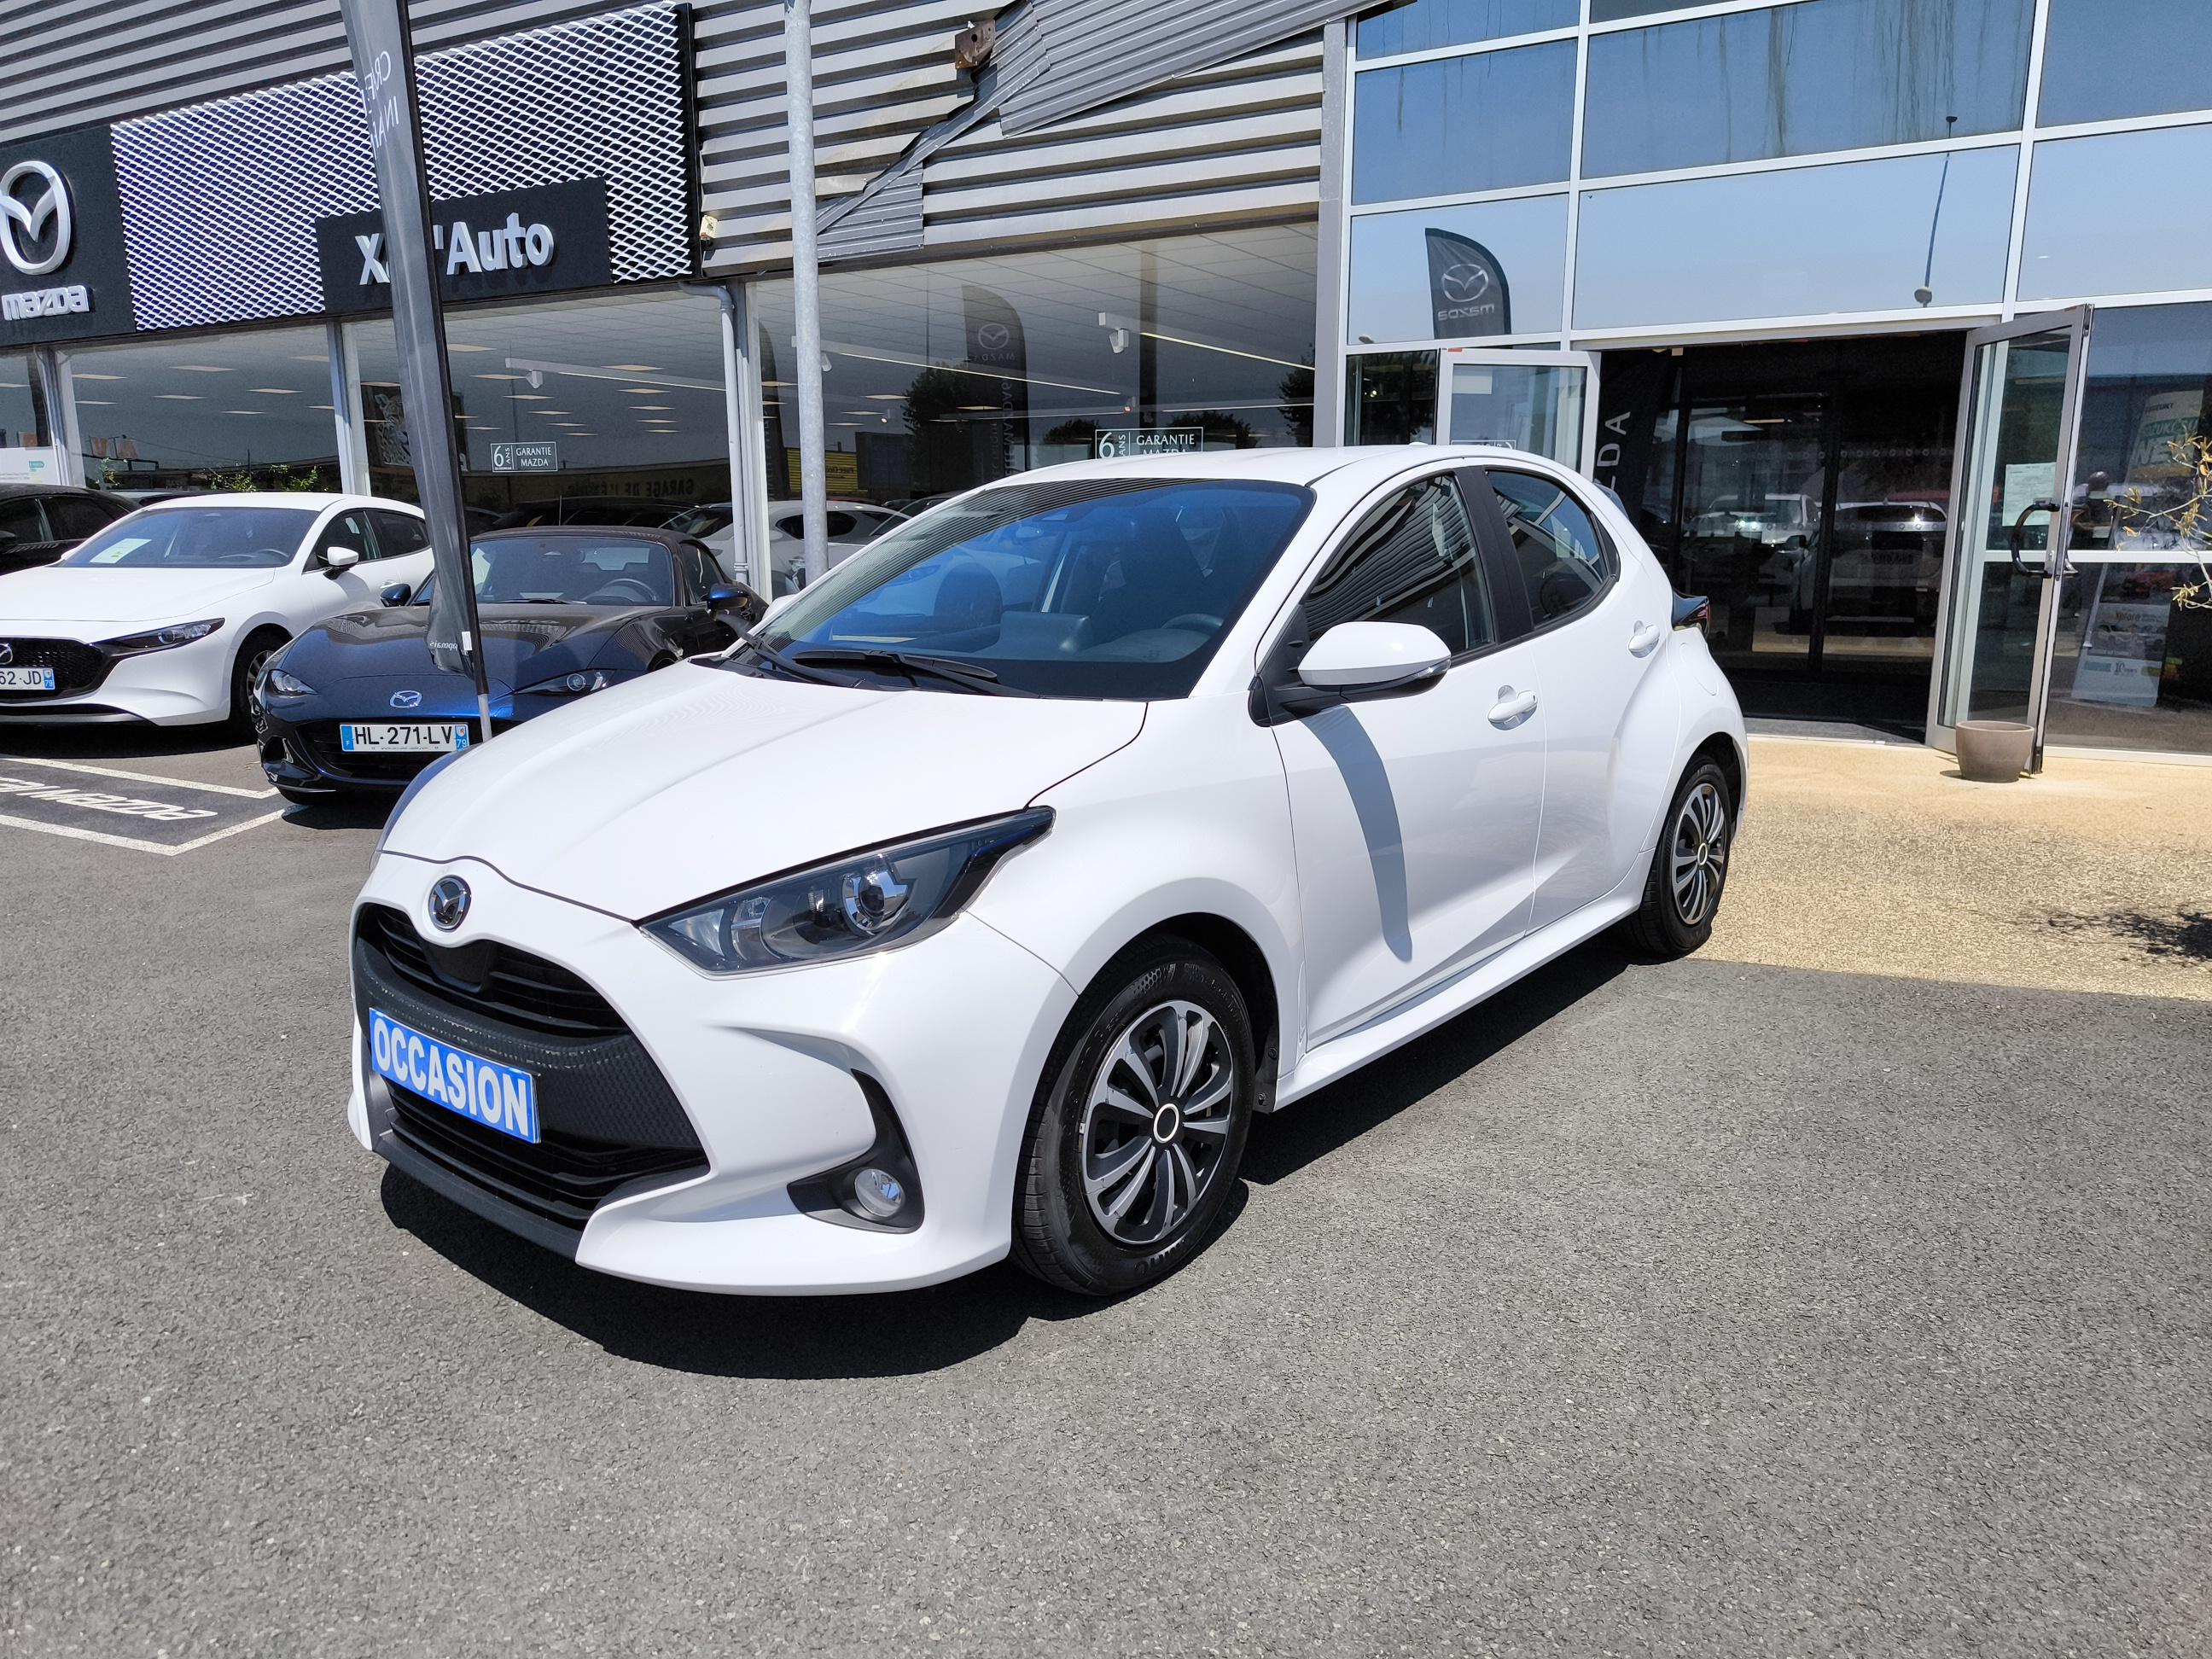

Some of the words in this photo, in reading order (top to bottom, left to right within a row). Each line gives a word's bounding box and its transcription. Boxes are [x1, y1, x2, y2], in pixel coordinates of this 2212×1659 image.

[1098, 432, 1115, 459] 6
[1136, 434, 1195, 445] GARANTIE
[493, 445, 504, 467] 6
[515, 446, 552, 457] GARANTIE
[521, 457, 549, 467] MAZDA
[354, 726, 452, 745] HL-271-LV
[457, 738, 467, 748] 79
[374, 1017, 529, 1137] OCCASION
